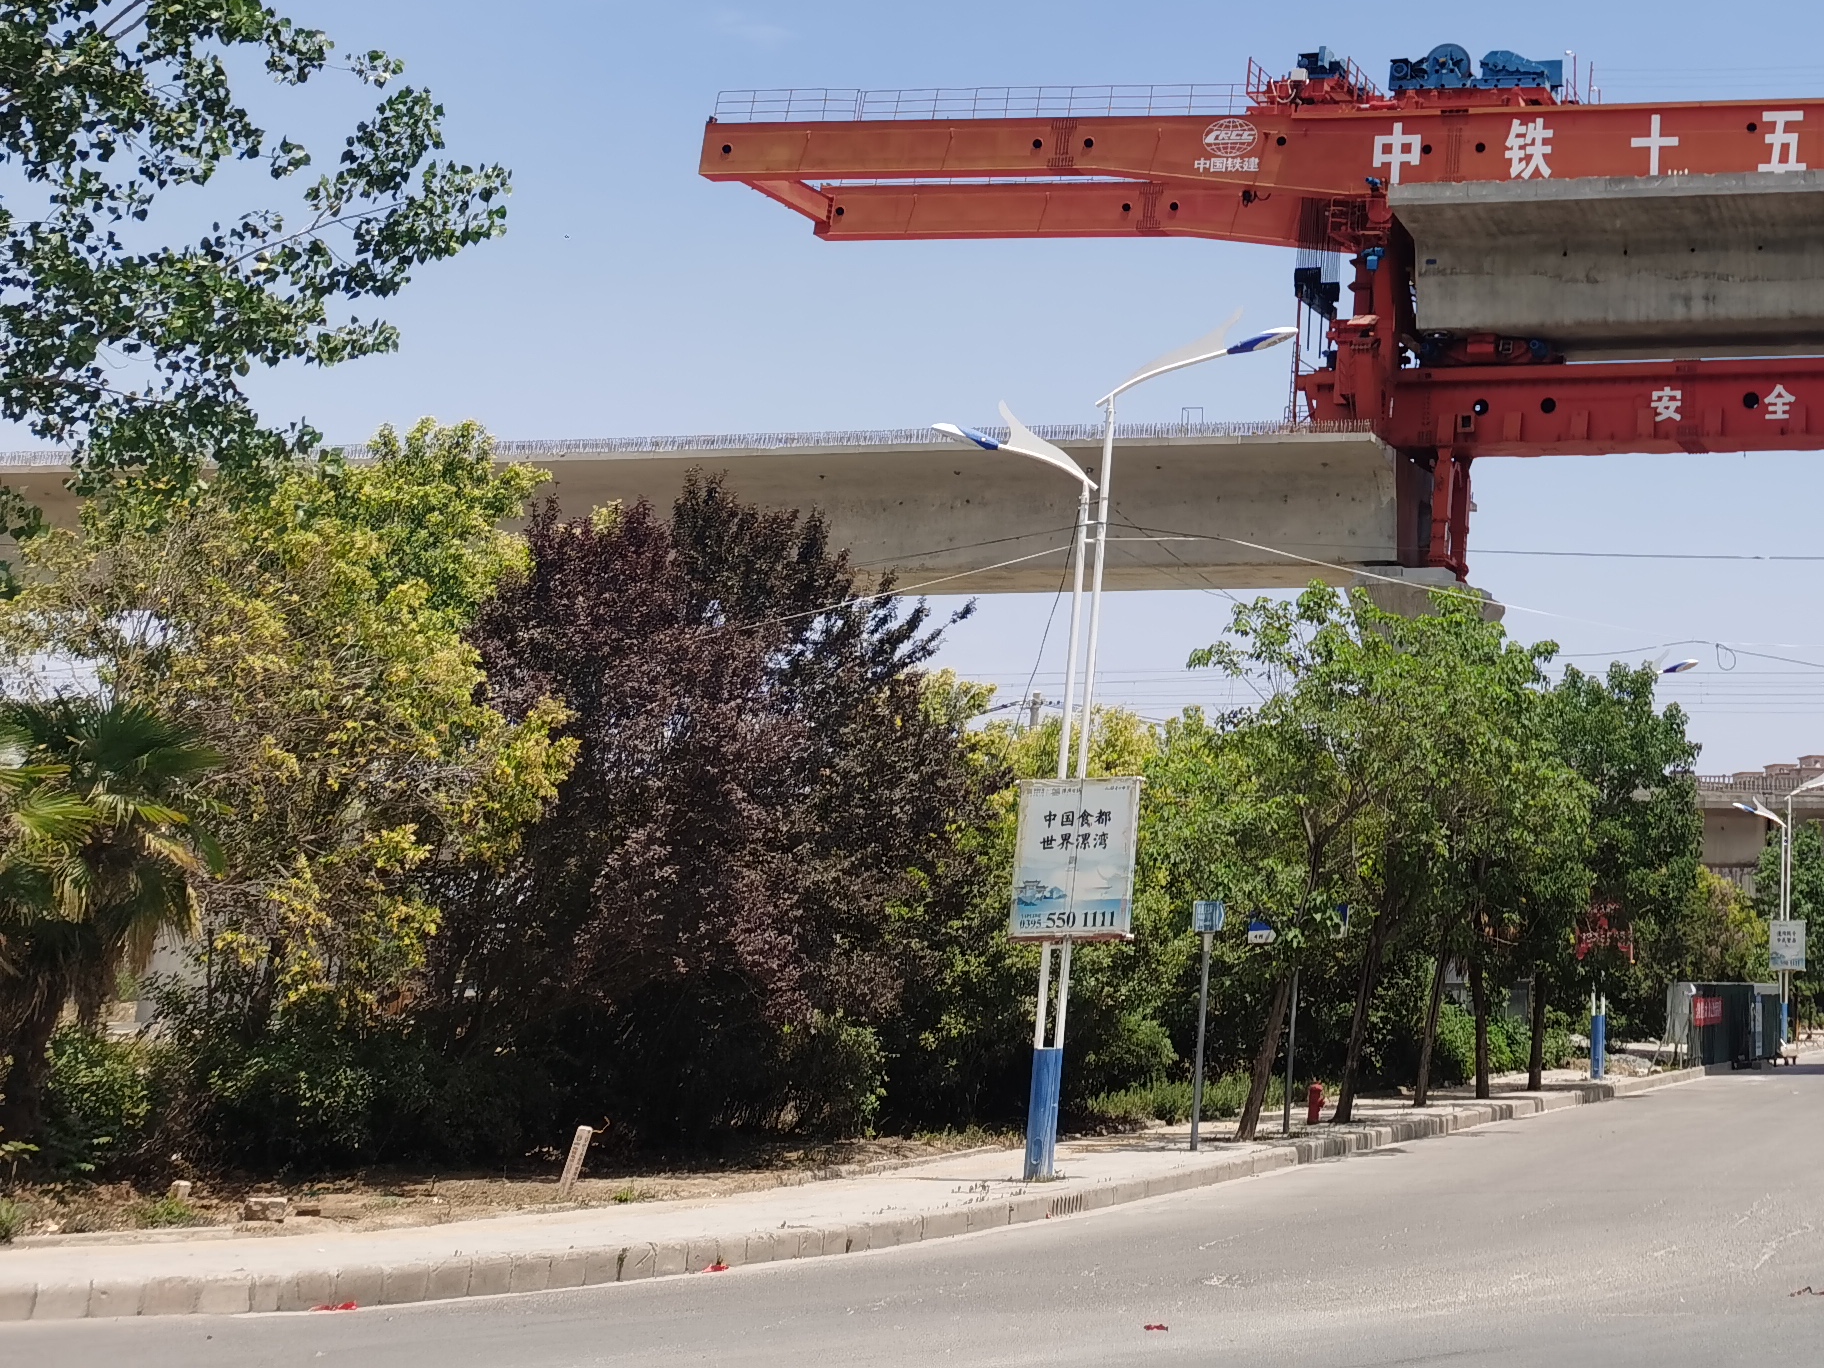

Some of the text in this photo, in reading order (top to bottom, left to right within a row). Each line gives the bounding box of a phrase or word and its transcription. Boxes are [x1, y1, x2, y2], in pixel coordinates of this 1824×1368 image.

[1204, 130, 1256, 144] CRCC
[1194, 157, 1259, 172] 中国铁建
[1043, 808, 1112, 829] 中国食都
[1019, 910, 1115, 929] 0395 550 1111
